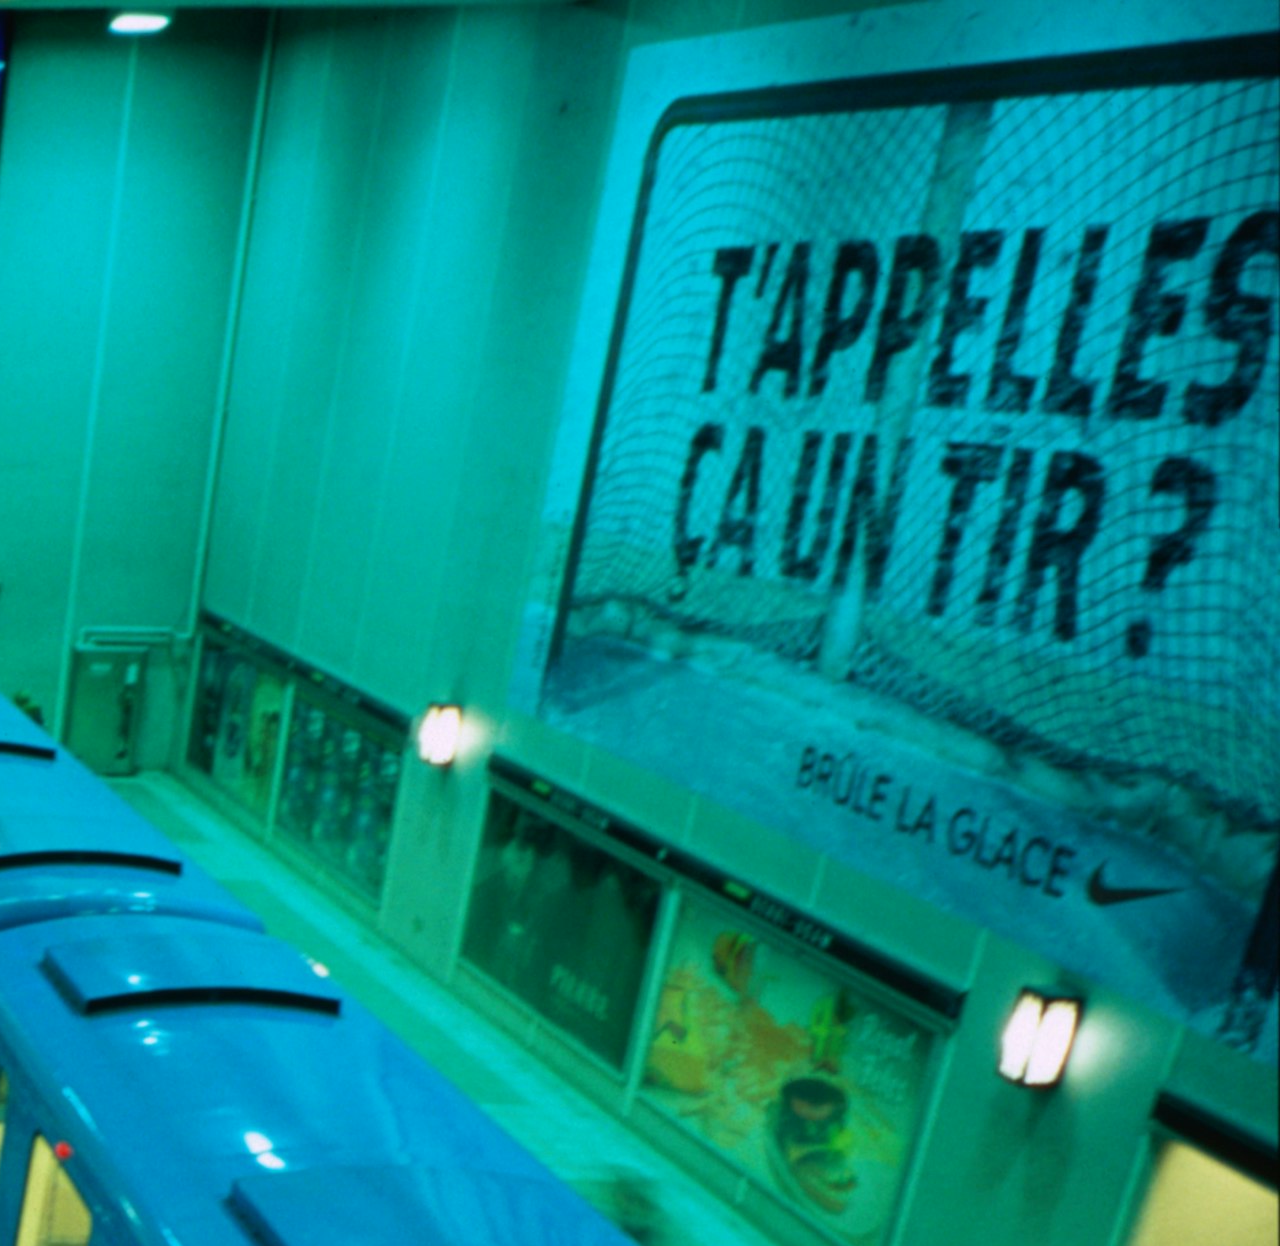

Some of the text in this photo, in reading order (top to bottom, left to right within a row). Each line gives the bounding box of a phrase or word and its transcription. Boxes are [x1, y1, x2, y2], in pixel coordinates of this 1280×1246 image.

[700, 210, 1280, 428] T'APPELLES
[778, 430, 914, 602] UN
[925, 441, 1107, 642] TIR
[796, 746, 1077, 898] BRÛLE LA GLACE
